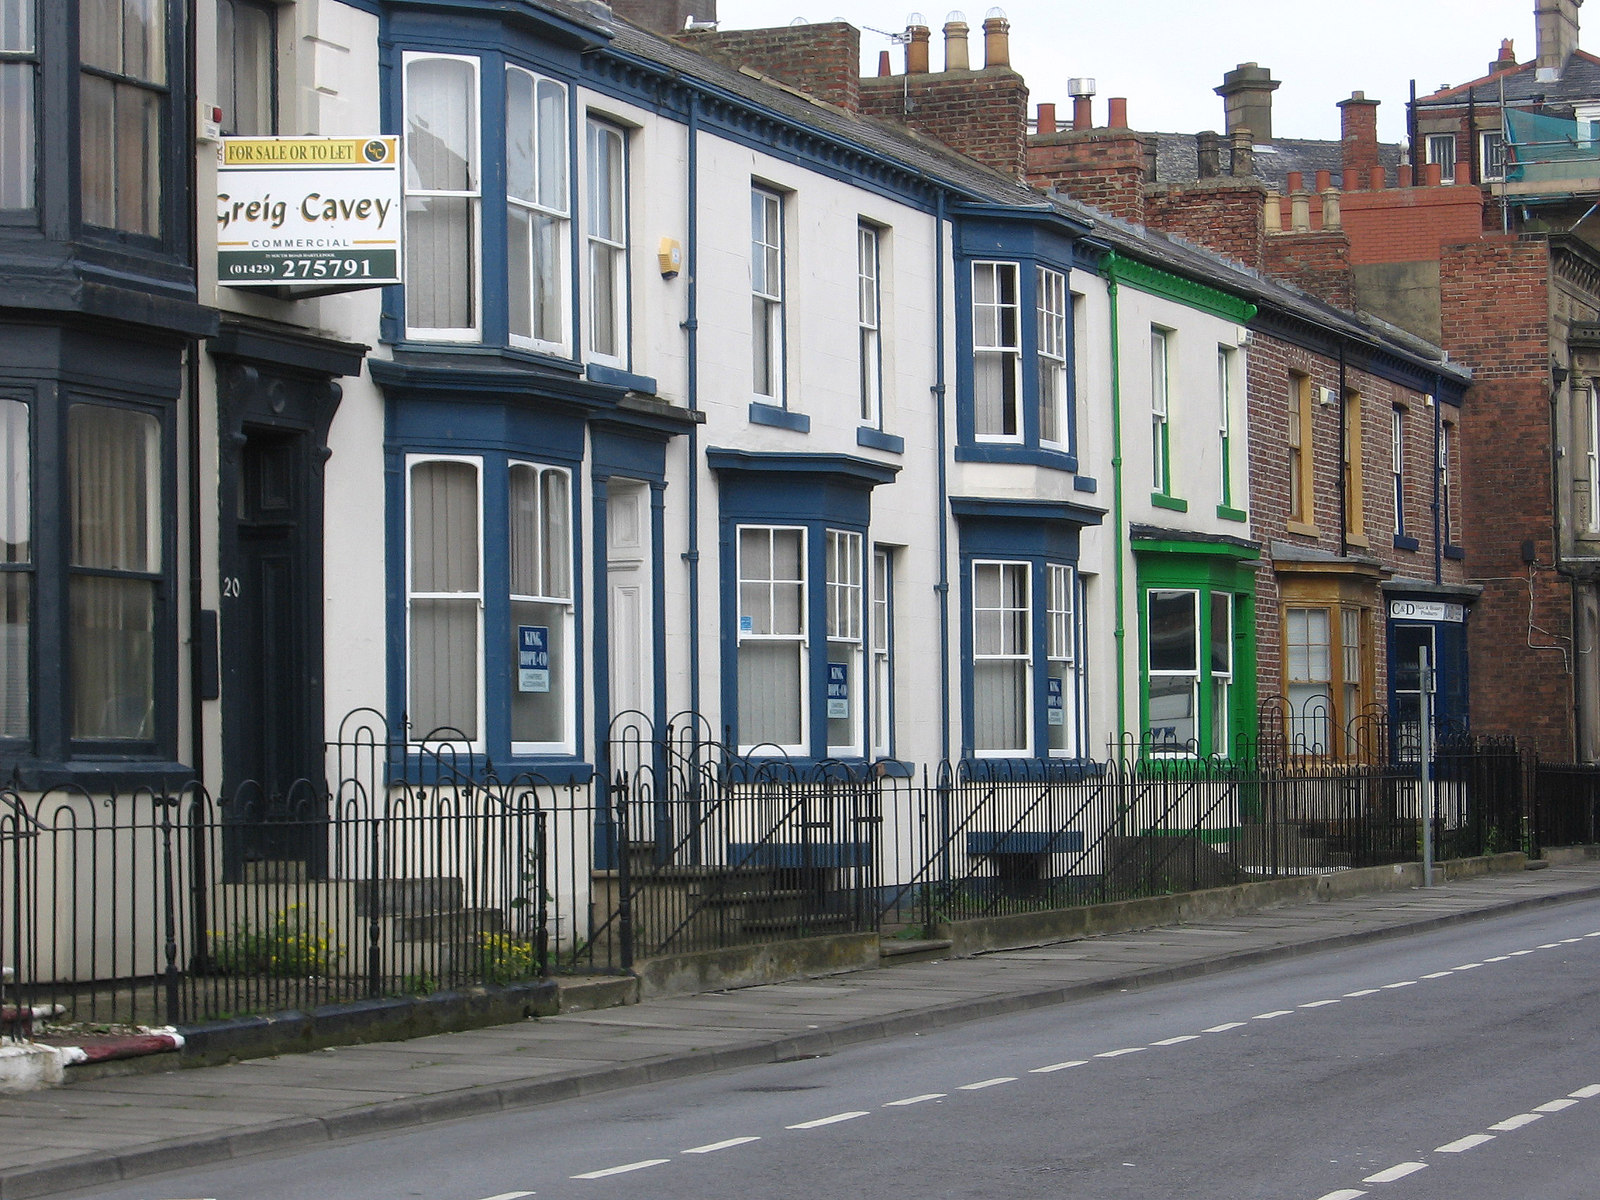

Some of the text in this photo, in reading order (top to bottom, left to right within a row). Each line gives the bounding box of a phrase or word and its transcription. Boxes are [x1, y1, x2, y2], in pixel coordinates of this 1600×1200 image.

[229, 145, 253, 160] FOR
[256, 145, 287, 160] SALE
[290, 145, 307, 160] OR
[310, 145, 327, 160] TO
[330, 145, 353, 160] LET
[216, 192, 392, 231] Greig Cavey
[251, 239, 350, 249] COMMERCIAL
[229, 259, 372, 278] (01429) 275791
[223, 576, 240, 598] 20
